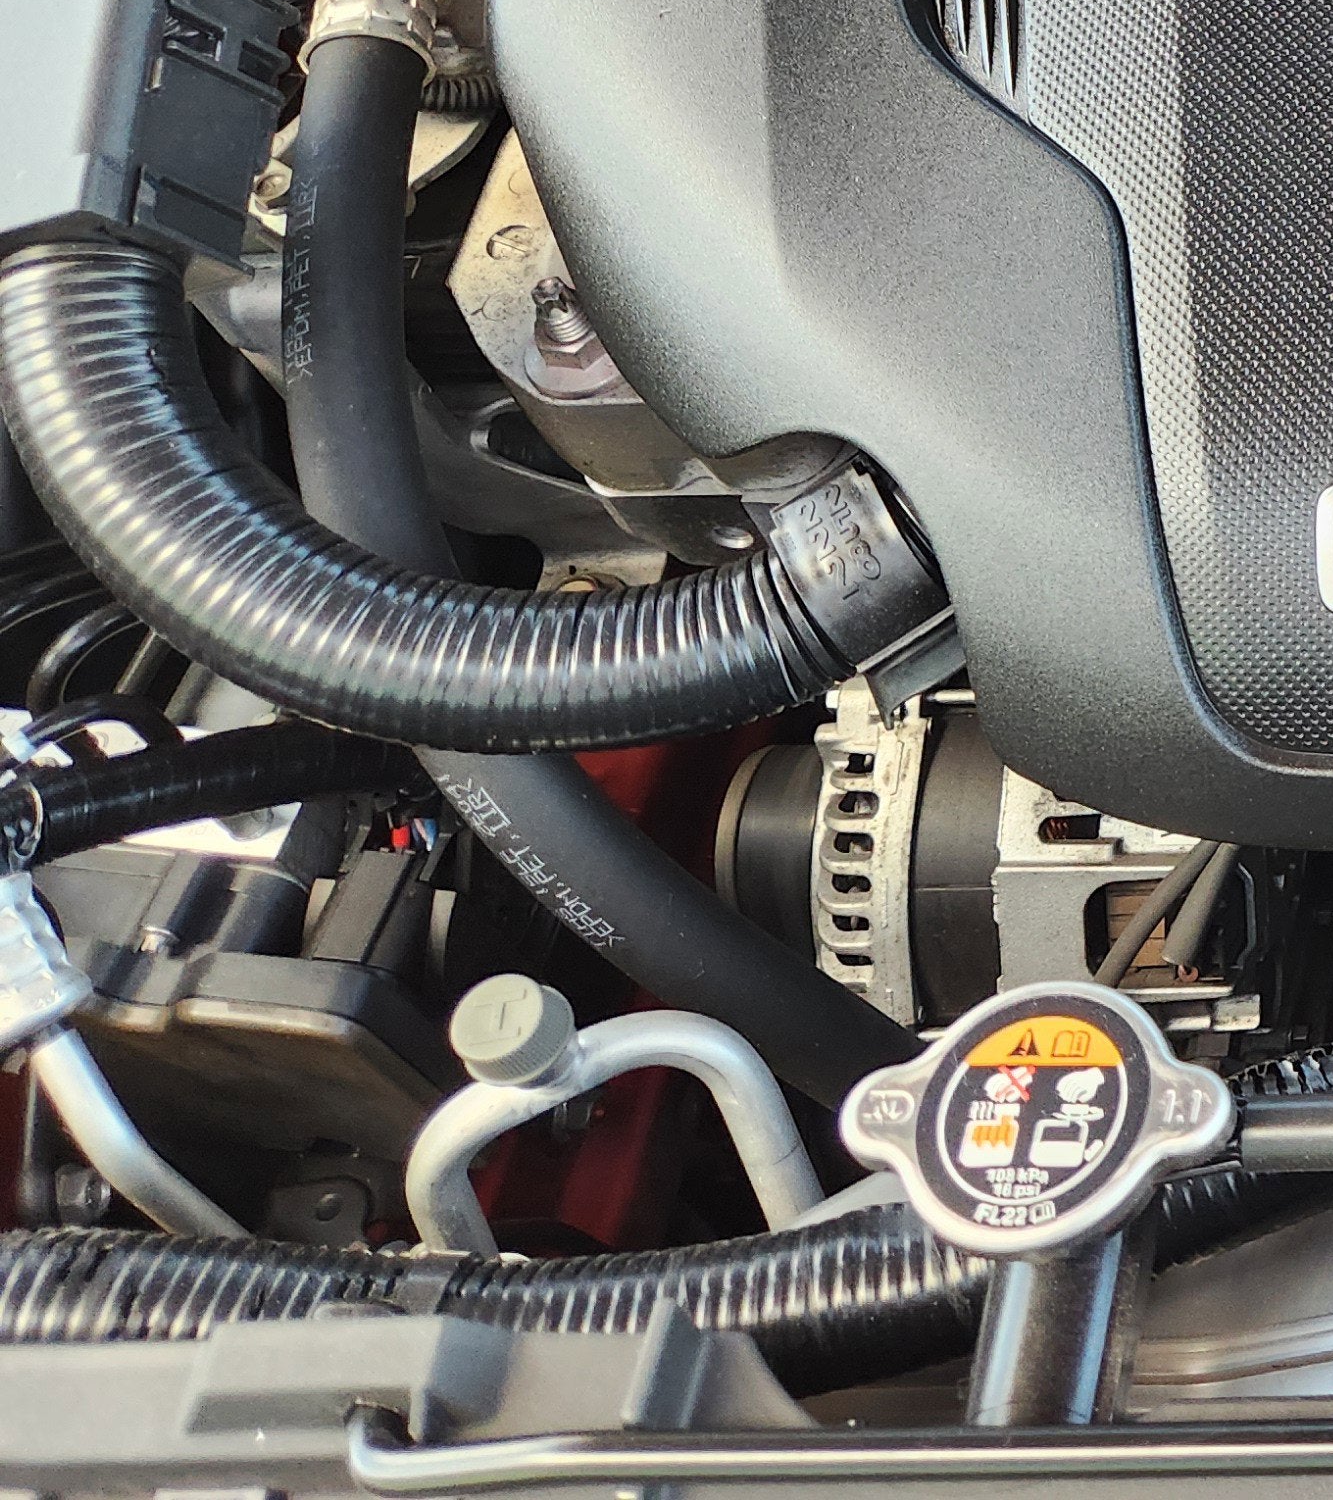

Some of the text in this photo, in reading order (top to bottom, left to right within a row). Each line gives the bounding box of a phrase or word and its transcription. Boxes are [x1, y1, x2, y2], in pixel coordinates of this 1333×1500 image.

[1162, 1088, 1206, 1124] 1.1
[1017, 1167, 1049, 1185] kPa
[1013, 1182, 1041, 1199] psi
[973, 1202, 1028, 1227] FL22
